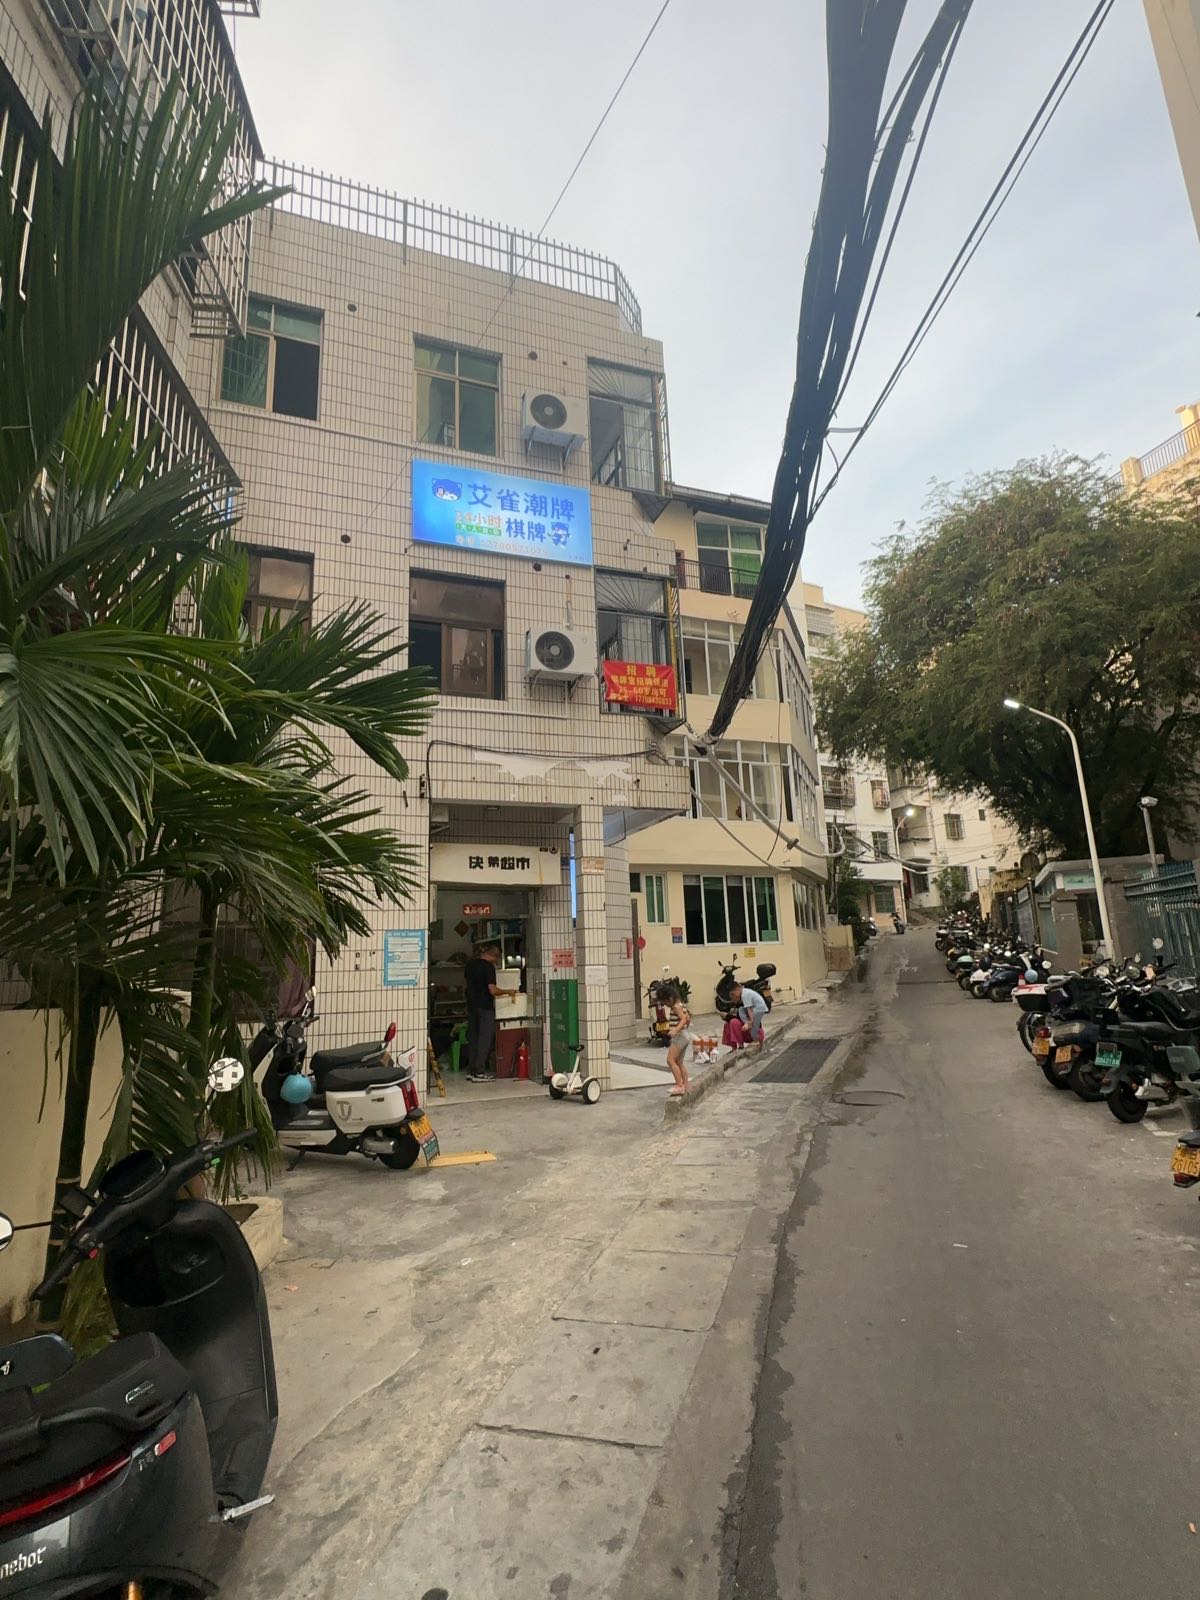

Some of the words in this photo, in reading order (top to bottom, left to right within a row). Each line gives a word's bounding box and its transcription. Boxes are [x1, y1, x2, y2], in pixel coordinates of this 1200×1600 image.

[467, 482, 575, 522] 艾雀潮牌
[505, 517, 547, 543] 棋牌
